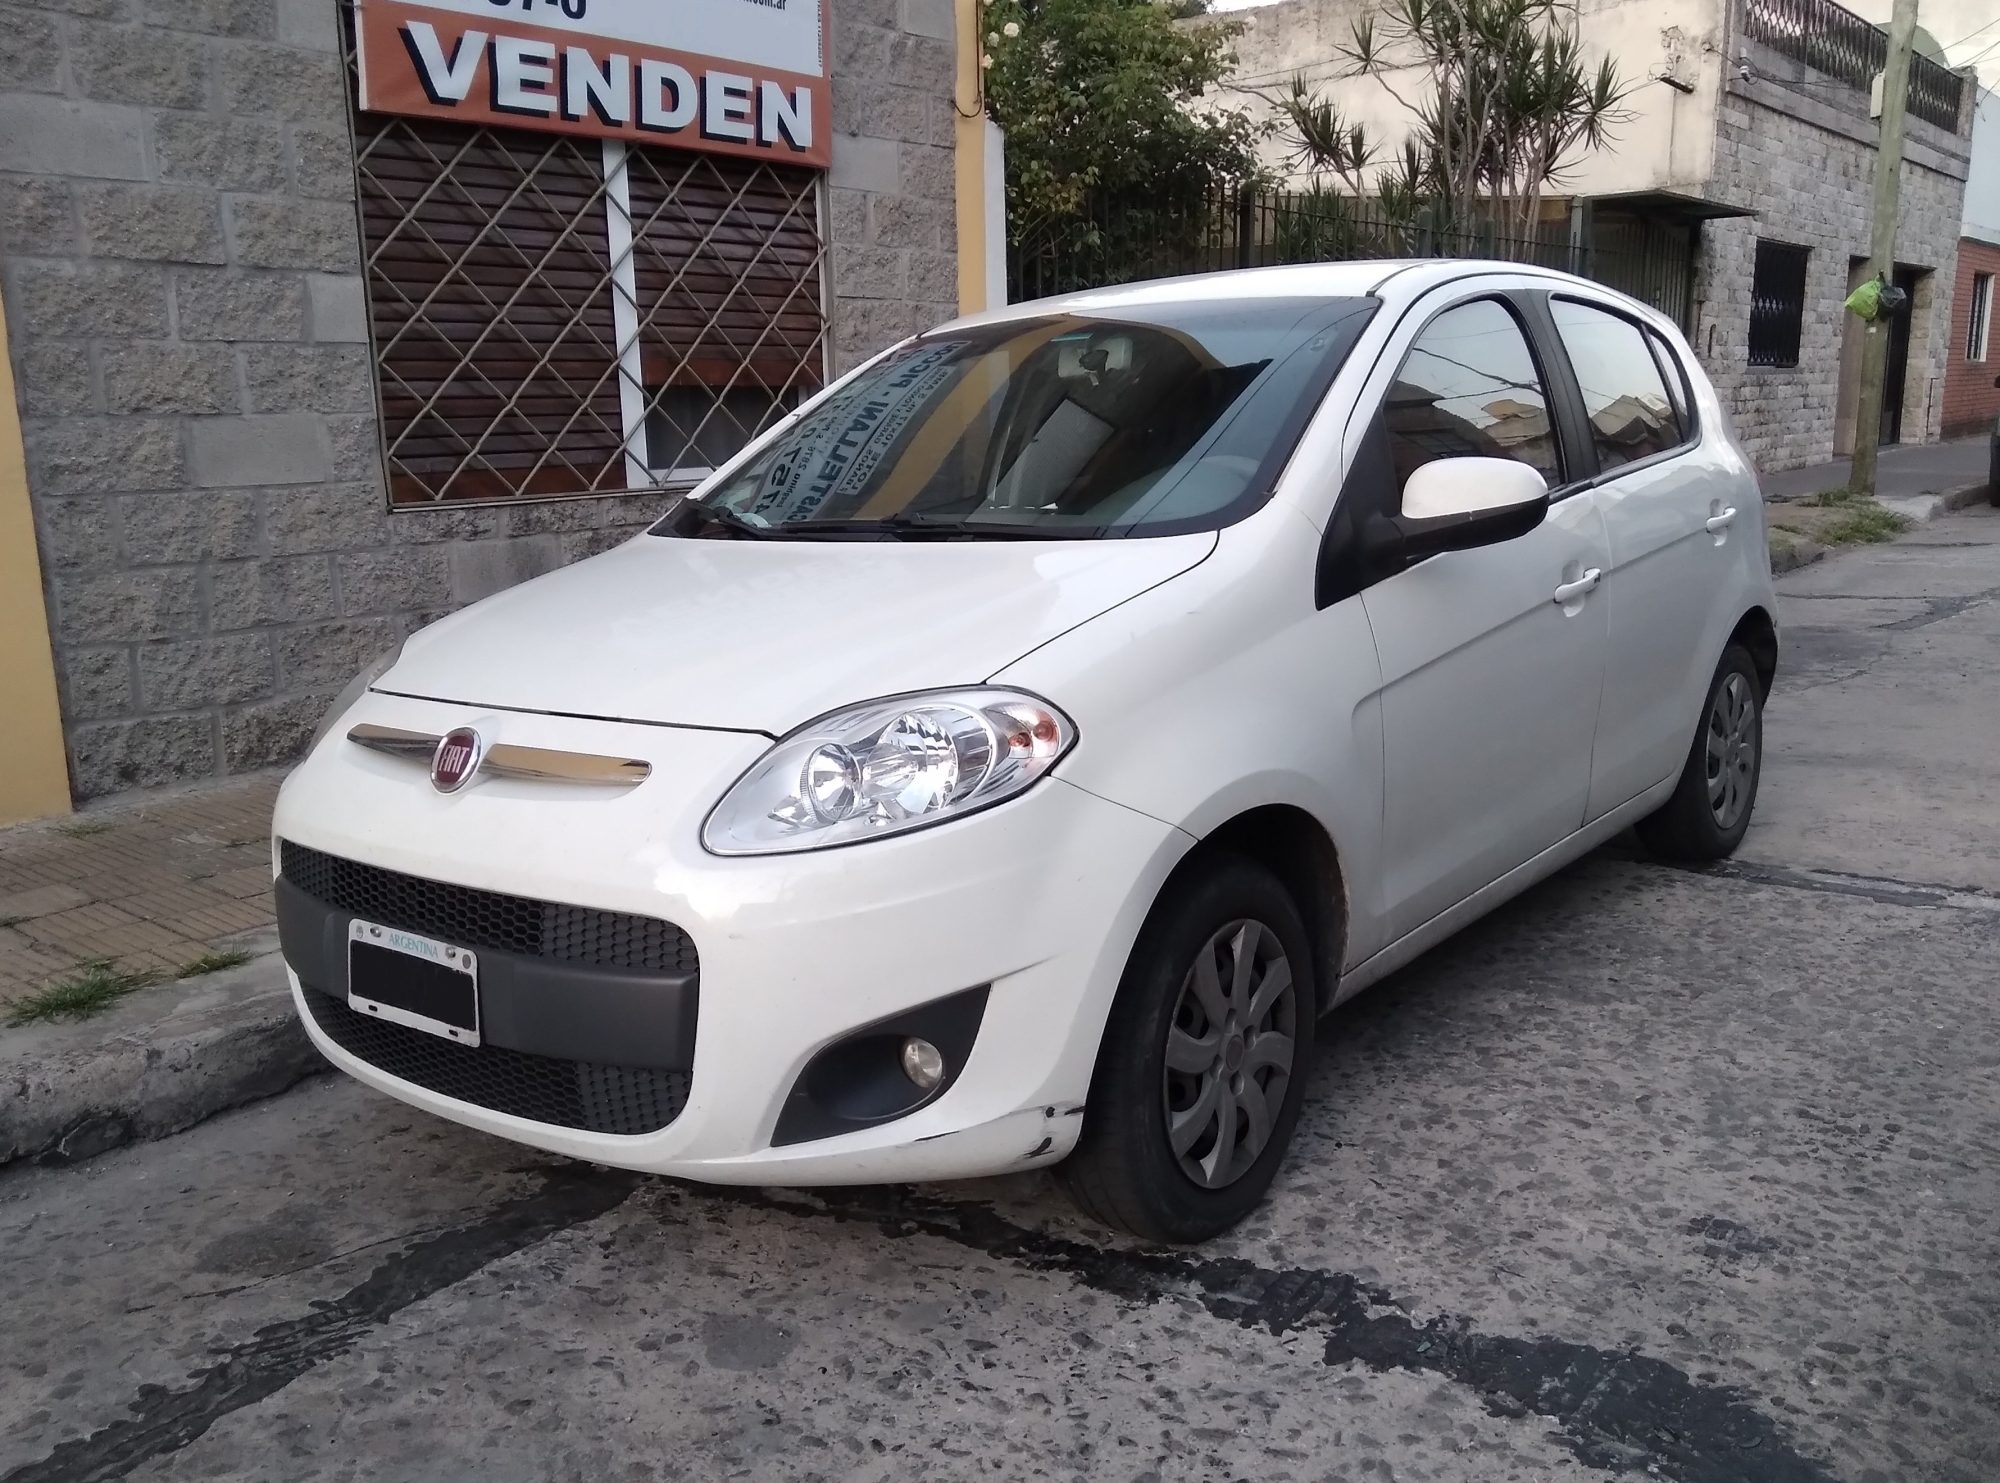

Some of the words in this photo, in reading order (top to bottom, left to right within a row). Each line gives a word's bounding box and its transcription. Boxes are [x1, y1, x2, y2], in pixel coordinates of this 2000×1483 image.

[401, 20, 812, 150] VENDEN
[439, 744, 470, 773] FIAT
[389, 932, 439, 959] ARGENTINA
